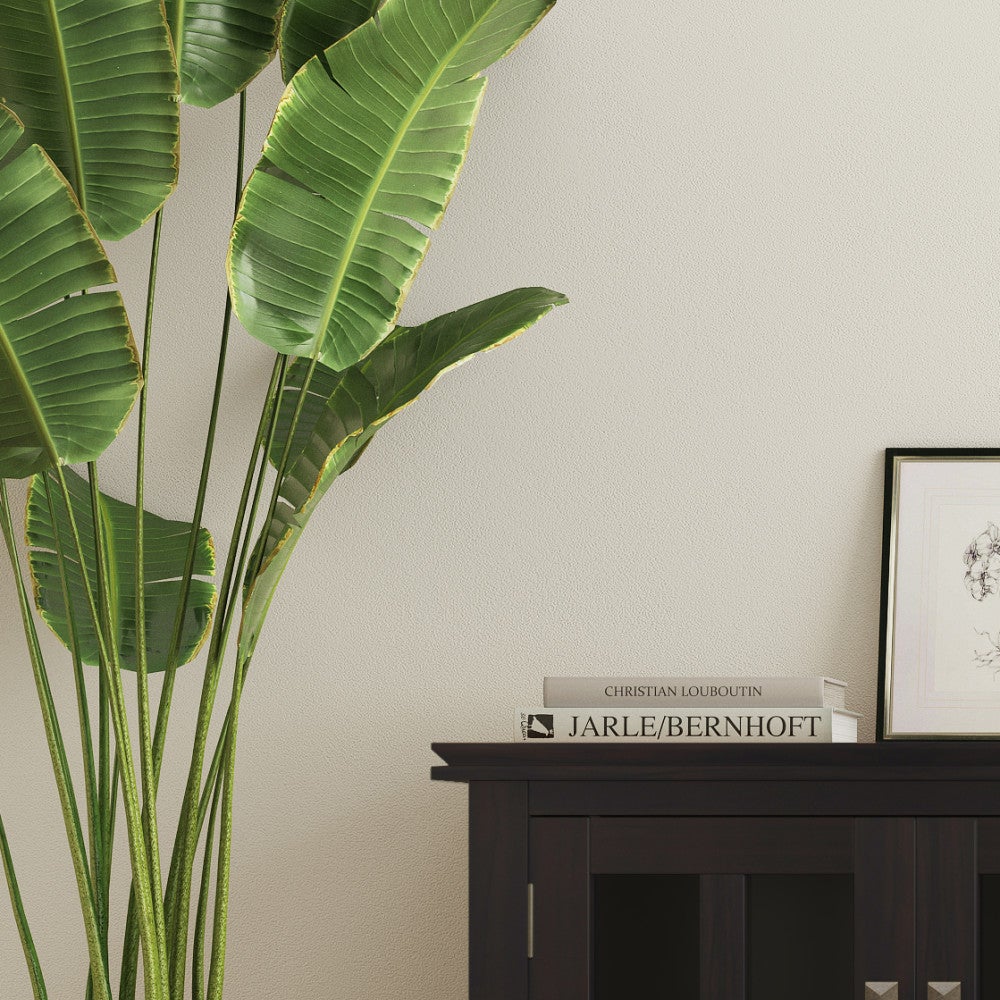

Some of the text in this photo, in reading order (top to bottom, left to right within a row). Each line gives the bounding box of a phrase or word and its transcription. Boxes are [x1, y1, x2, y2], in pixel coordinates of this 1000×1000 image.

[604, 685, 763, 697] CHRISTIAN LOUBOUTIN
[568, 715, 822, 740] JARLE/BERNHOFT
